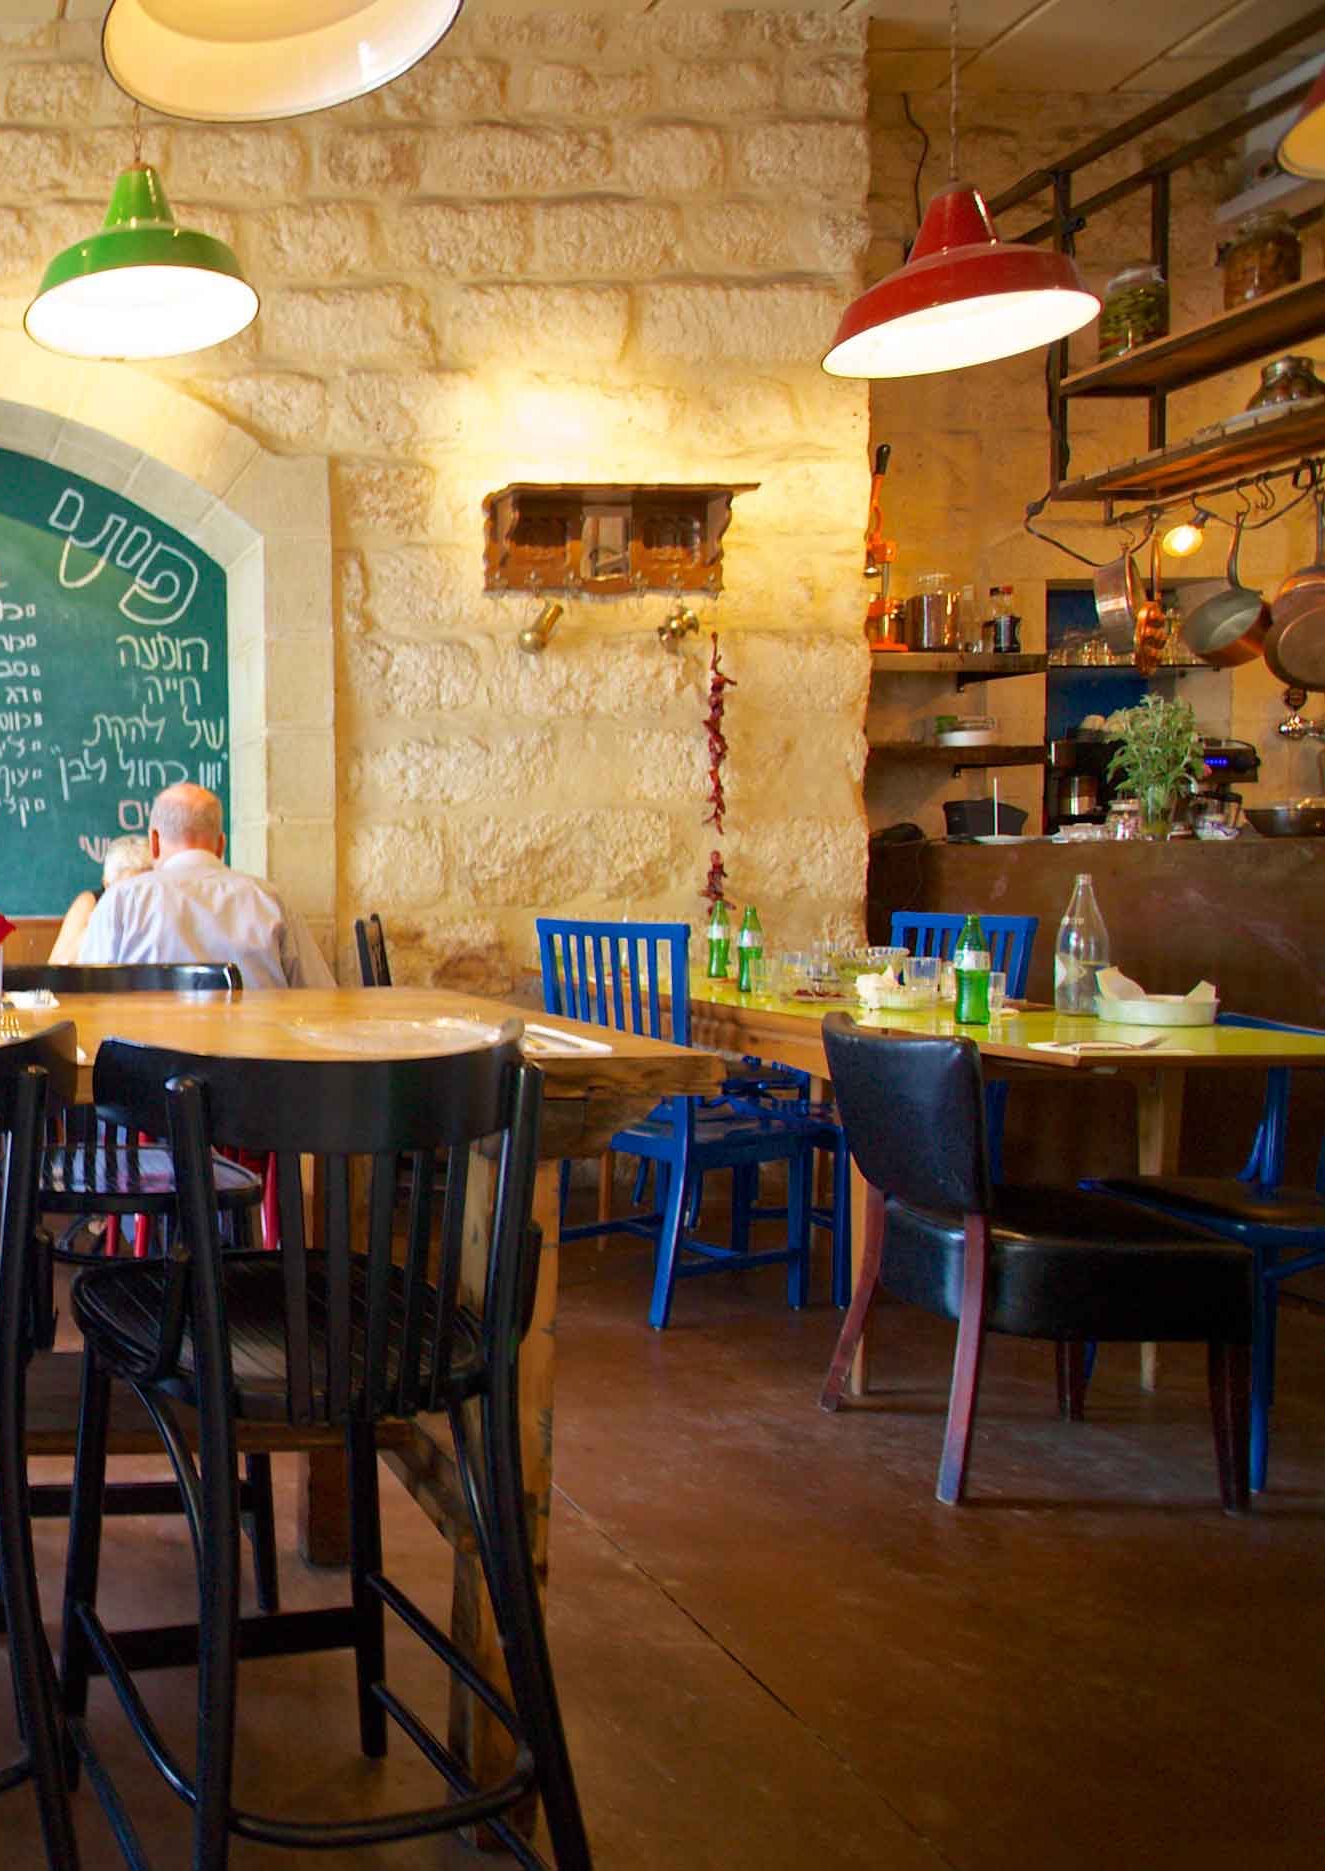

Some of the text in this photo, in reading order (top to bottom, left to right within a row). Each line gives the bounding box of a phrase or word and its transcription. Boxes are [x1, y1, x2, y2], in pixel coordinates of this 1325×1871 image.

[116, 632, 209, 672] הופעה
[6, 685, 30, 704] דג
[143, 675, 202, 706] חייה
[182, 704, 225, 750] של
